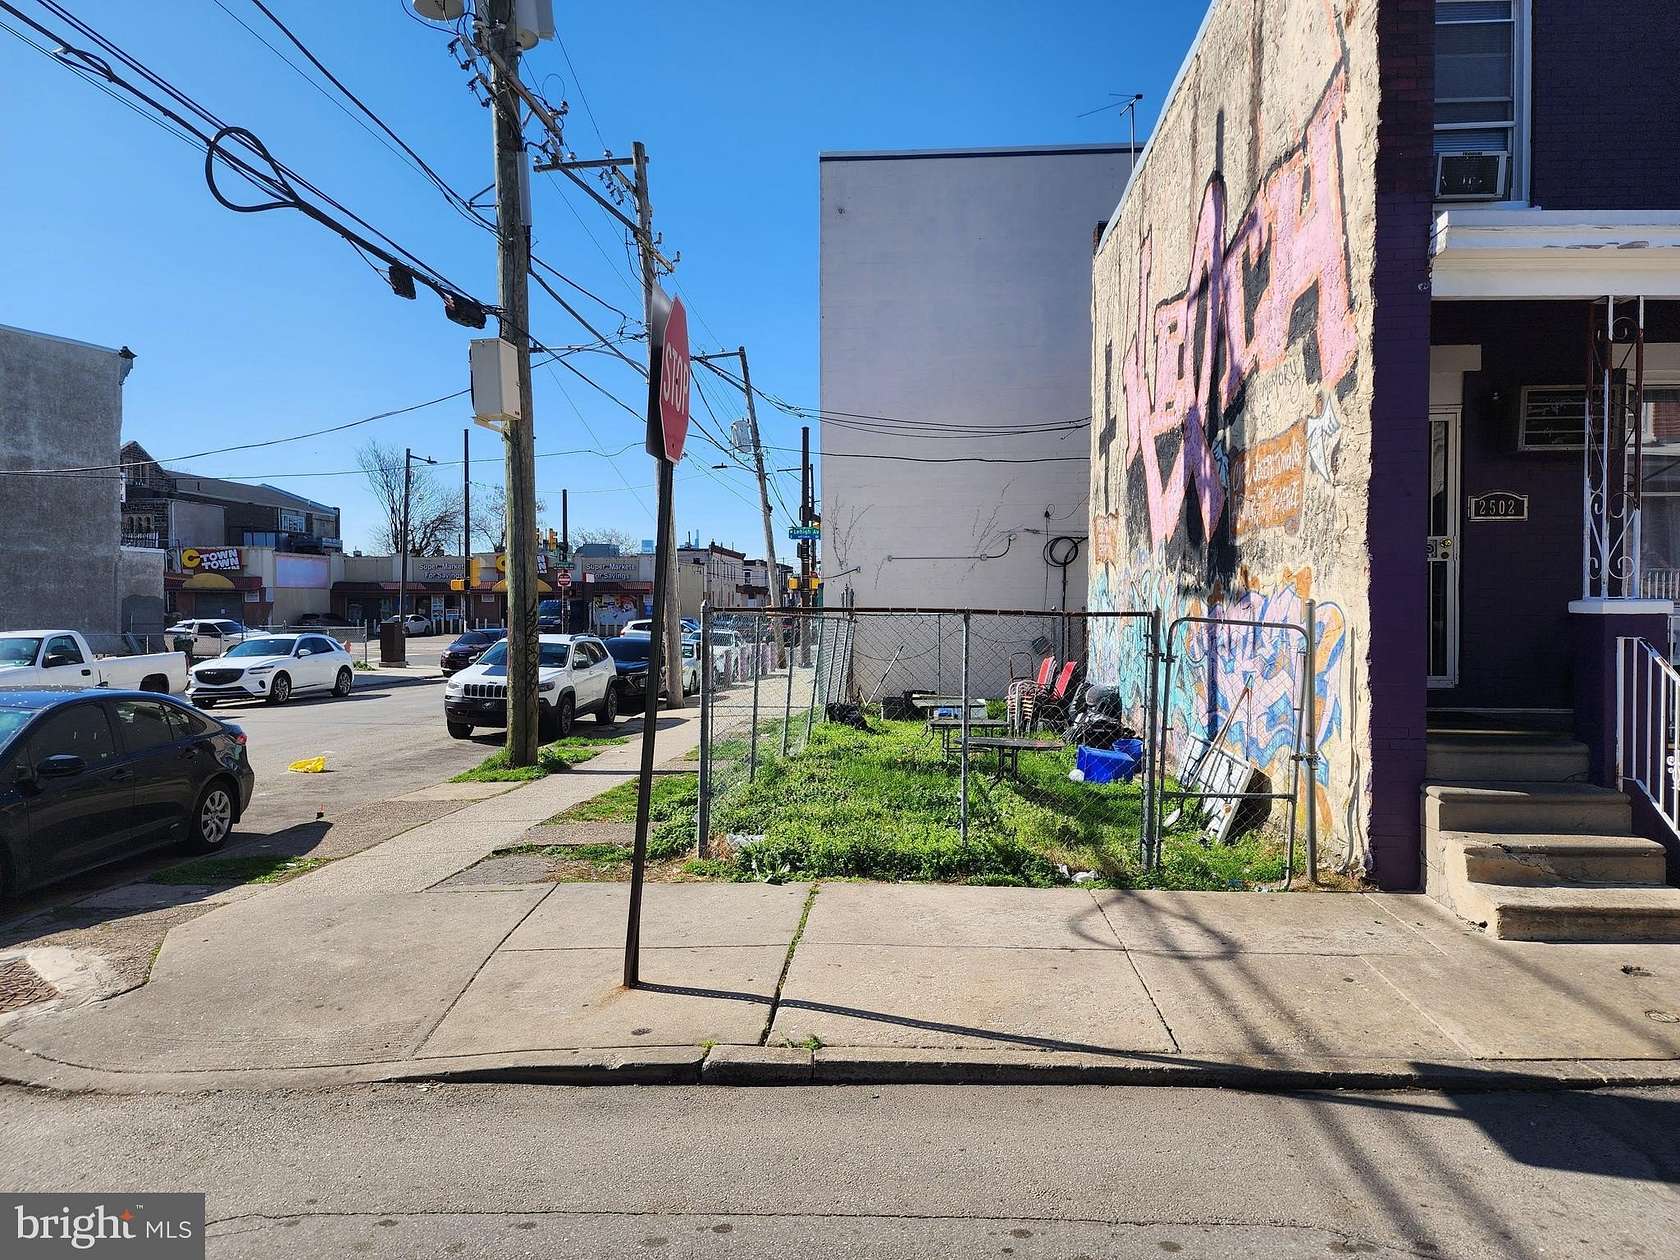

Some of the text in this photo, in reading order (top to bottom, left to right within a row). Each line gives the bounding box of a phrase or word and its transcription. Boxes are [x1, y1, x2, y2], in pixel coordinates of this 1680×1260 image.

[664, 342, 688, 414] STOP
[1479, 501, 1514, 514] 2502
[200, 549, 238, 562] TOWN
[202, 557, 240, 570] TOWN
